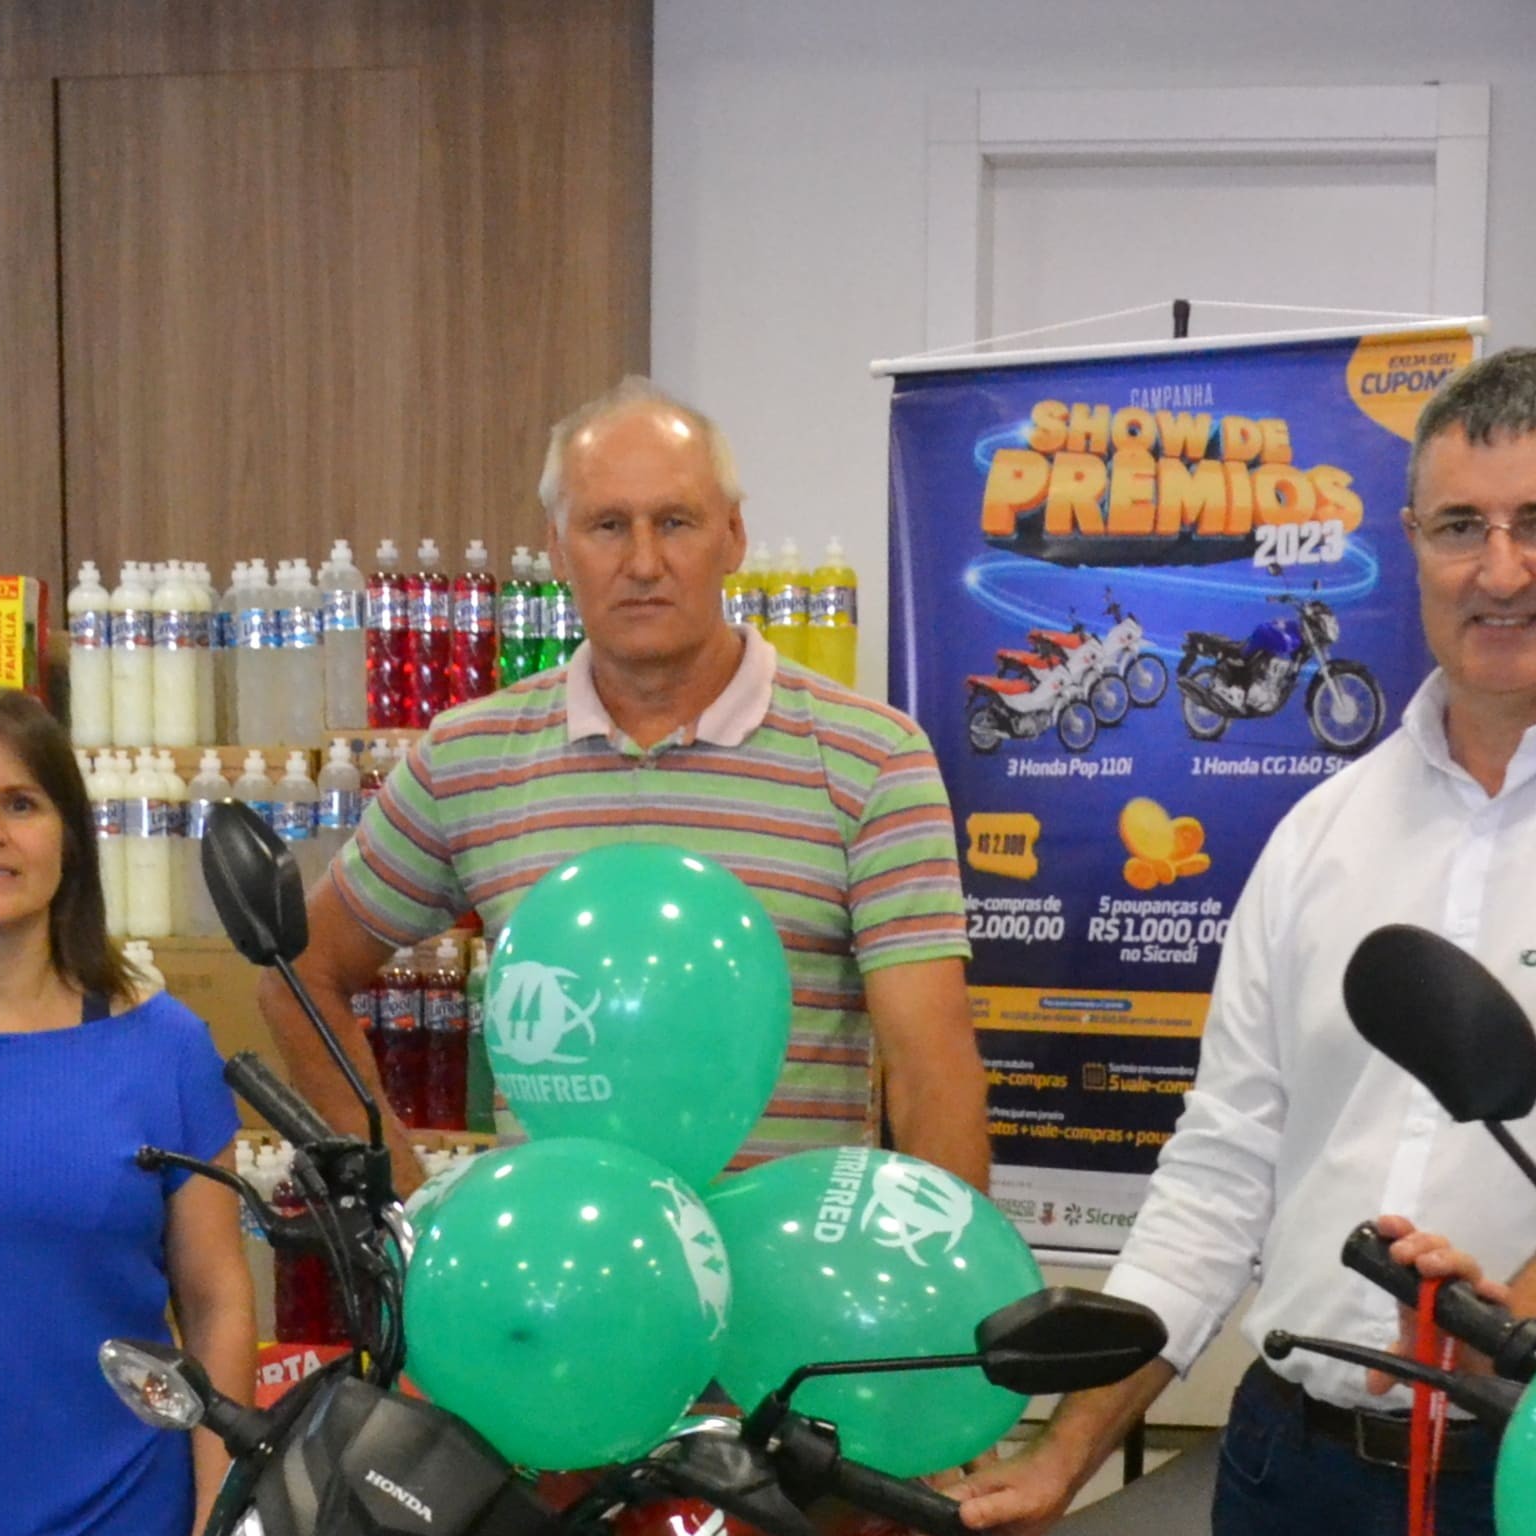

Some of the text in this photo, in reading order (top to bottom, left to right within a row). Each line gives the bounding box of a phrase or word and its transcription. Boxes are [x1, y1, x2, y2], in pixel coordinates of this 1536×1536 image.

[1361, 369, 1454, 395] CUPOM
[1130, 383, 1214, 409] CAMPANHA
[1028, 399, 1293, 465] SHOW DE
[1253, 520, 1345, 567] 2023
[1007, 759, 1018, 775] 3
[1020, 758, 1066, 776] Honda
[1069, 758, 1098, 779] Pop
[1191, 757, 1322, 775] 1 Honda CG 160
[1044, 895, 1063, 912] de
[1099, 896, 1222, 919] 5 poupanças de
[969, 915, 1065, 945] 2.000,00
[1120, 944, 1198, 964] no Sicredi
[1086, 1207, 1136, 1227] Sicred
[366, 1469, 432, 1524] HONDA
